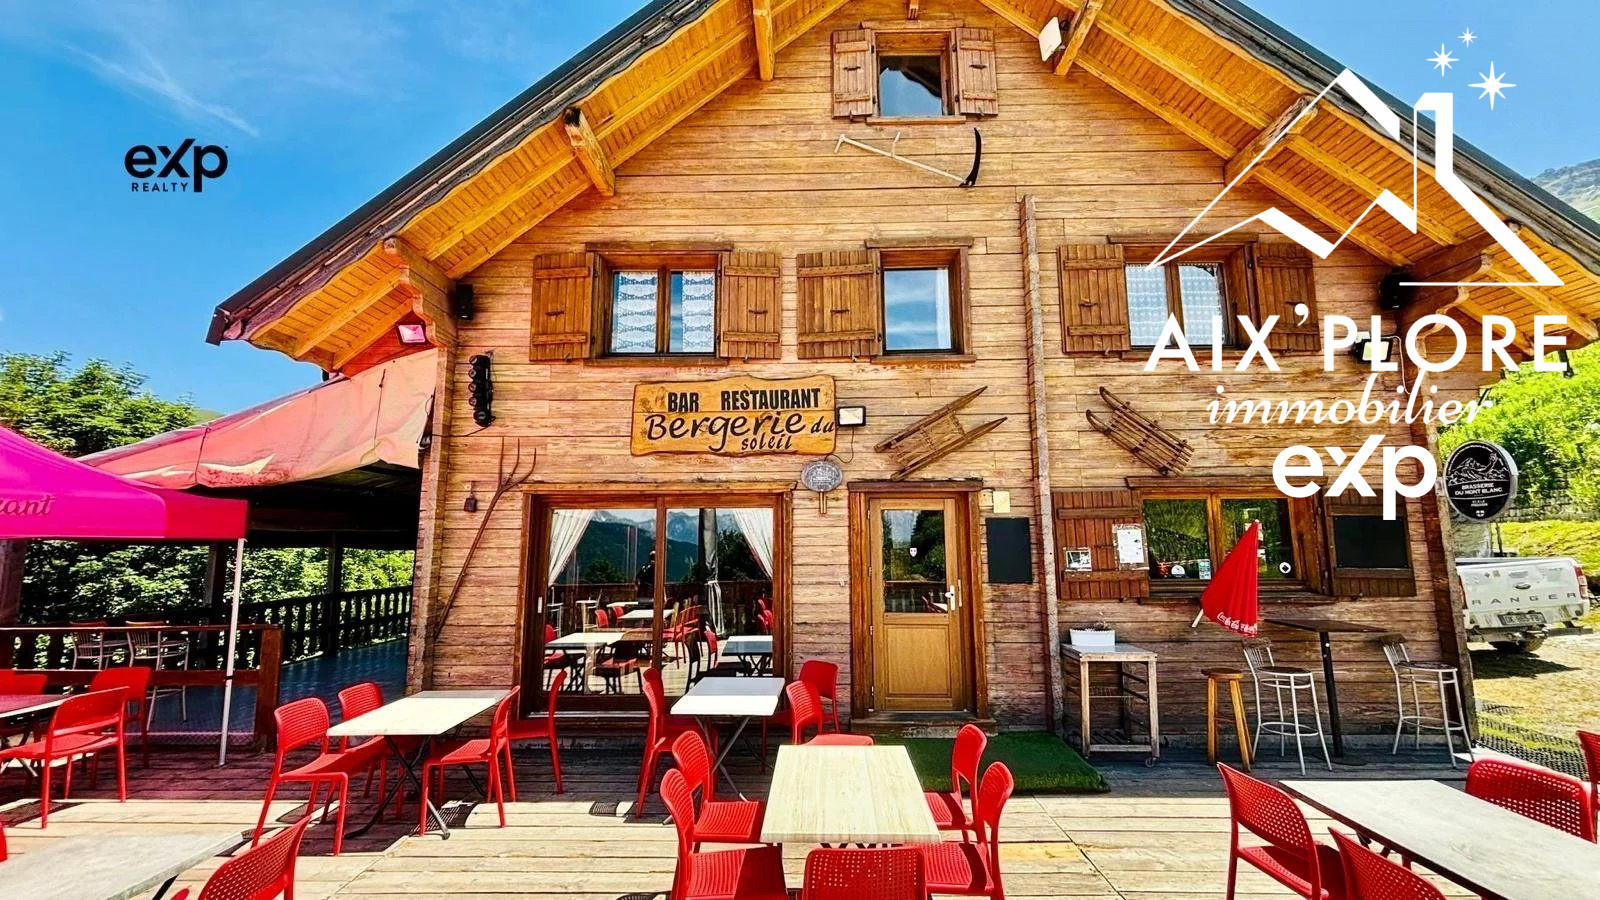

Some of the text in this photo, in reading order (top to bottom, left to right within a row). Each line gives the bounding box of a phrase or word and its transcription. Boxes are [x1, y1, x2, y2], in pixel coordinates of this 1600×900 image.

[667, 388, 821, 412] BAR RESTAURANT
[644, 410, 836, 452] Bergerie du
[740, 432, 793, 451] soleil
[1471, 592, 1577, 606] RANGER
